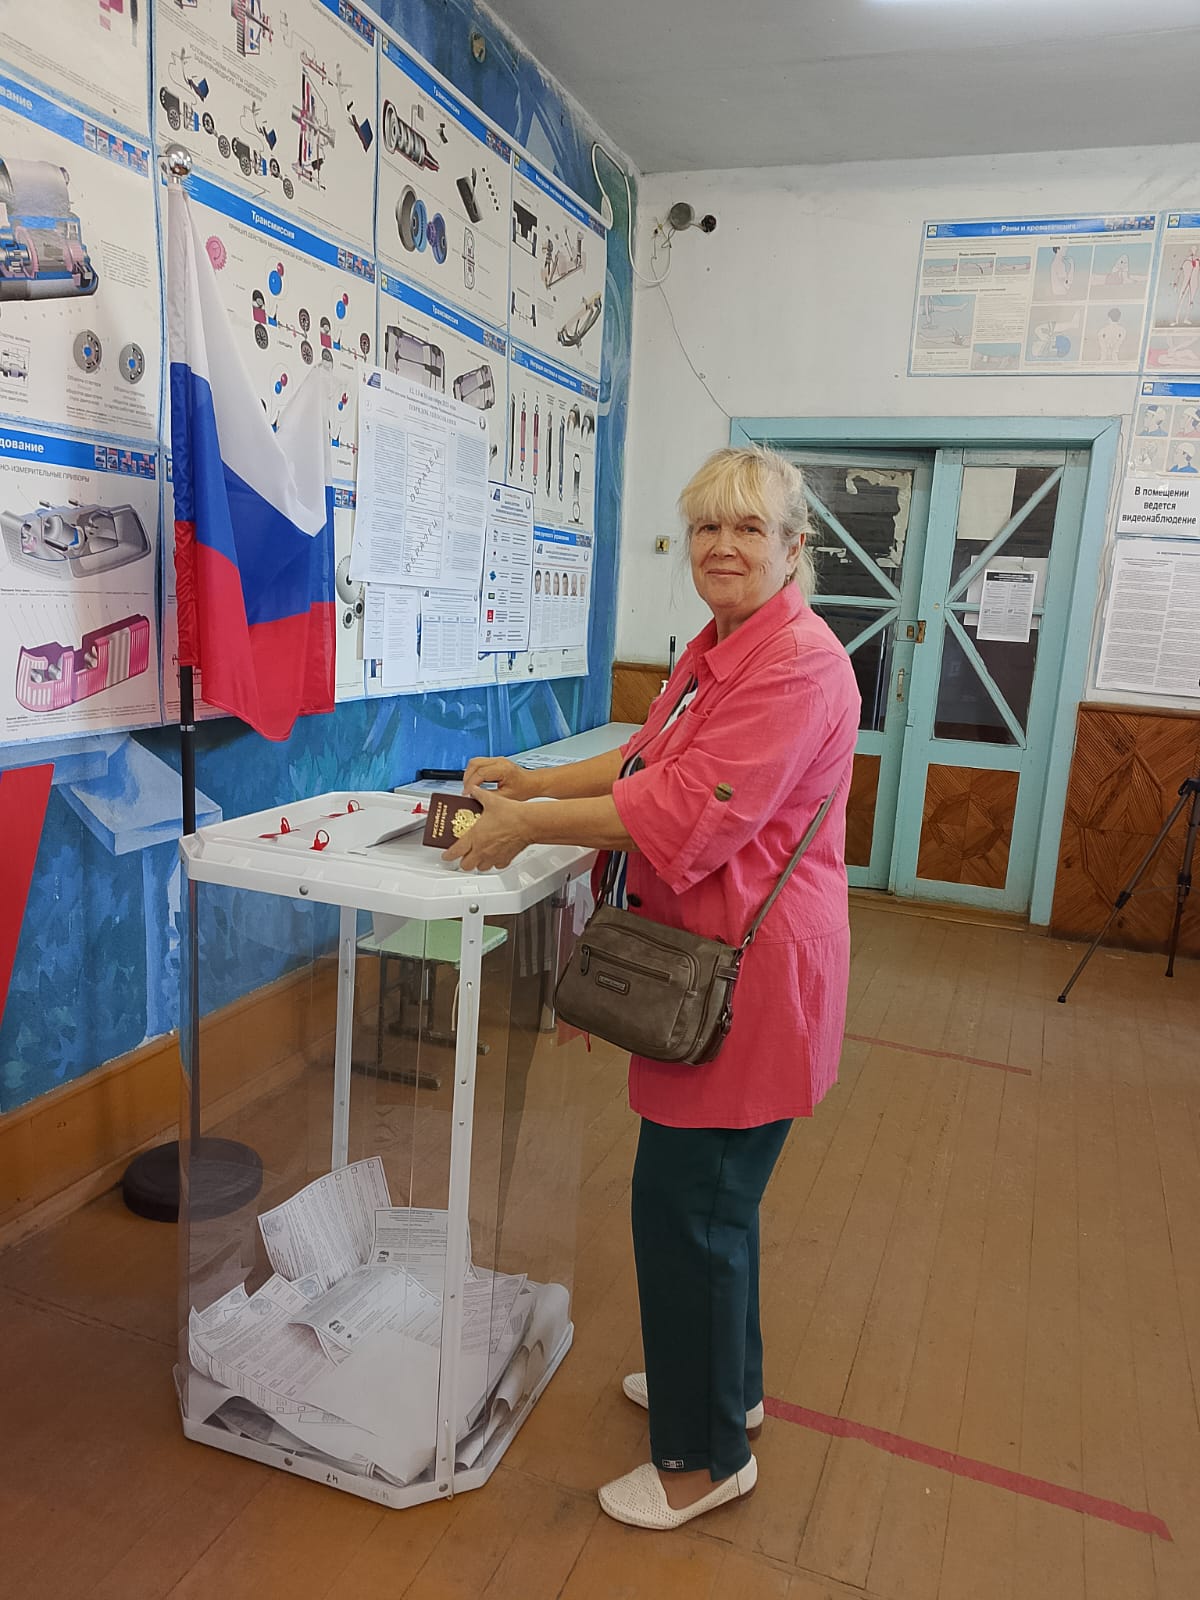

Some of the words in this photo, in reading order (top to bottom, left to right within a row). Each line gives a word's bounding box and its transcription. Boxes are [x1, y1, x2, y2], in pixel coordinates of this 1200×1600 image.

[433, 85, 460, 115] Трансмиссия
[251, 209, 295, 240] Трансмиссия
[432, 304, 459, 326] Трансмиссия
[1134, 486, 1141, 496] В
[1142, 487, 1190, 498] помещении
[1143, 501, 1177, 511] ведется
[1121, 513, 1197, 525] видеонаблюдение
